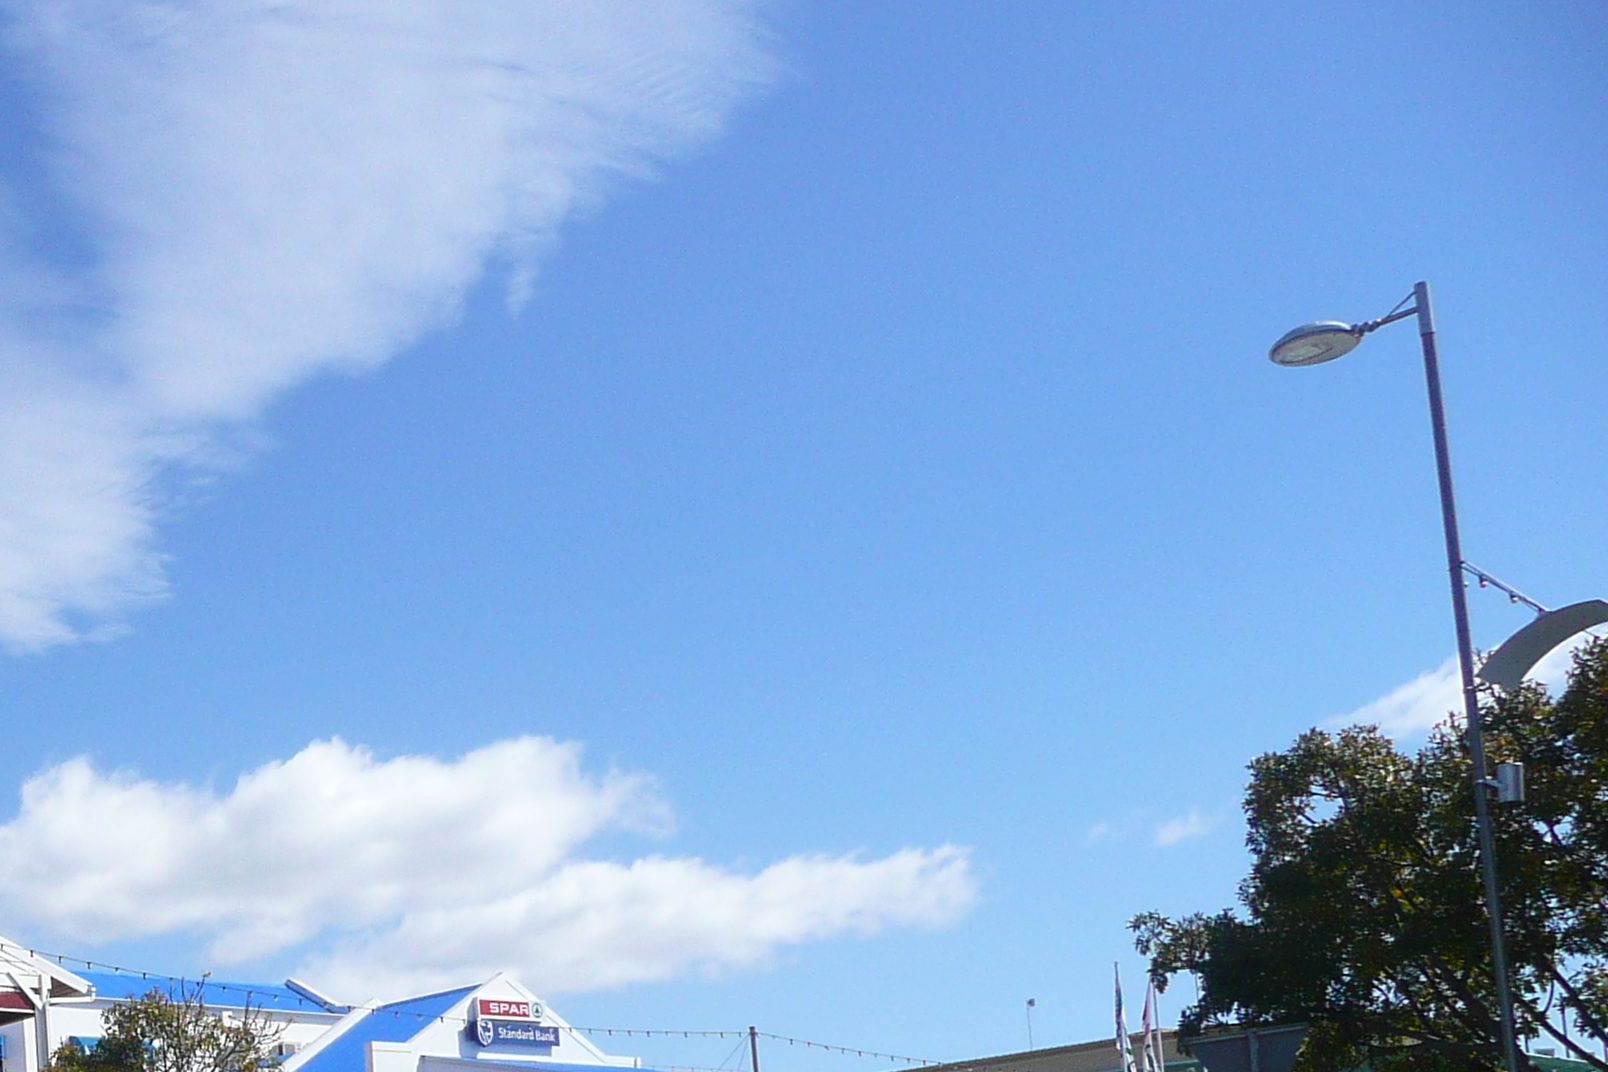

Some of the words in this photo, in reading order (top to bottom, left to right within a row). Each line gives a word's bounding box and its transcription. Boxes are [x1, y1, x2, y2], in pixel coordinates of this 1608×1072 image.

[489, 1002, 529, 1016] SPAR
[498, 1026, 535, 1041] Standard
[535, 1028, 556, 1042] Bank
